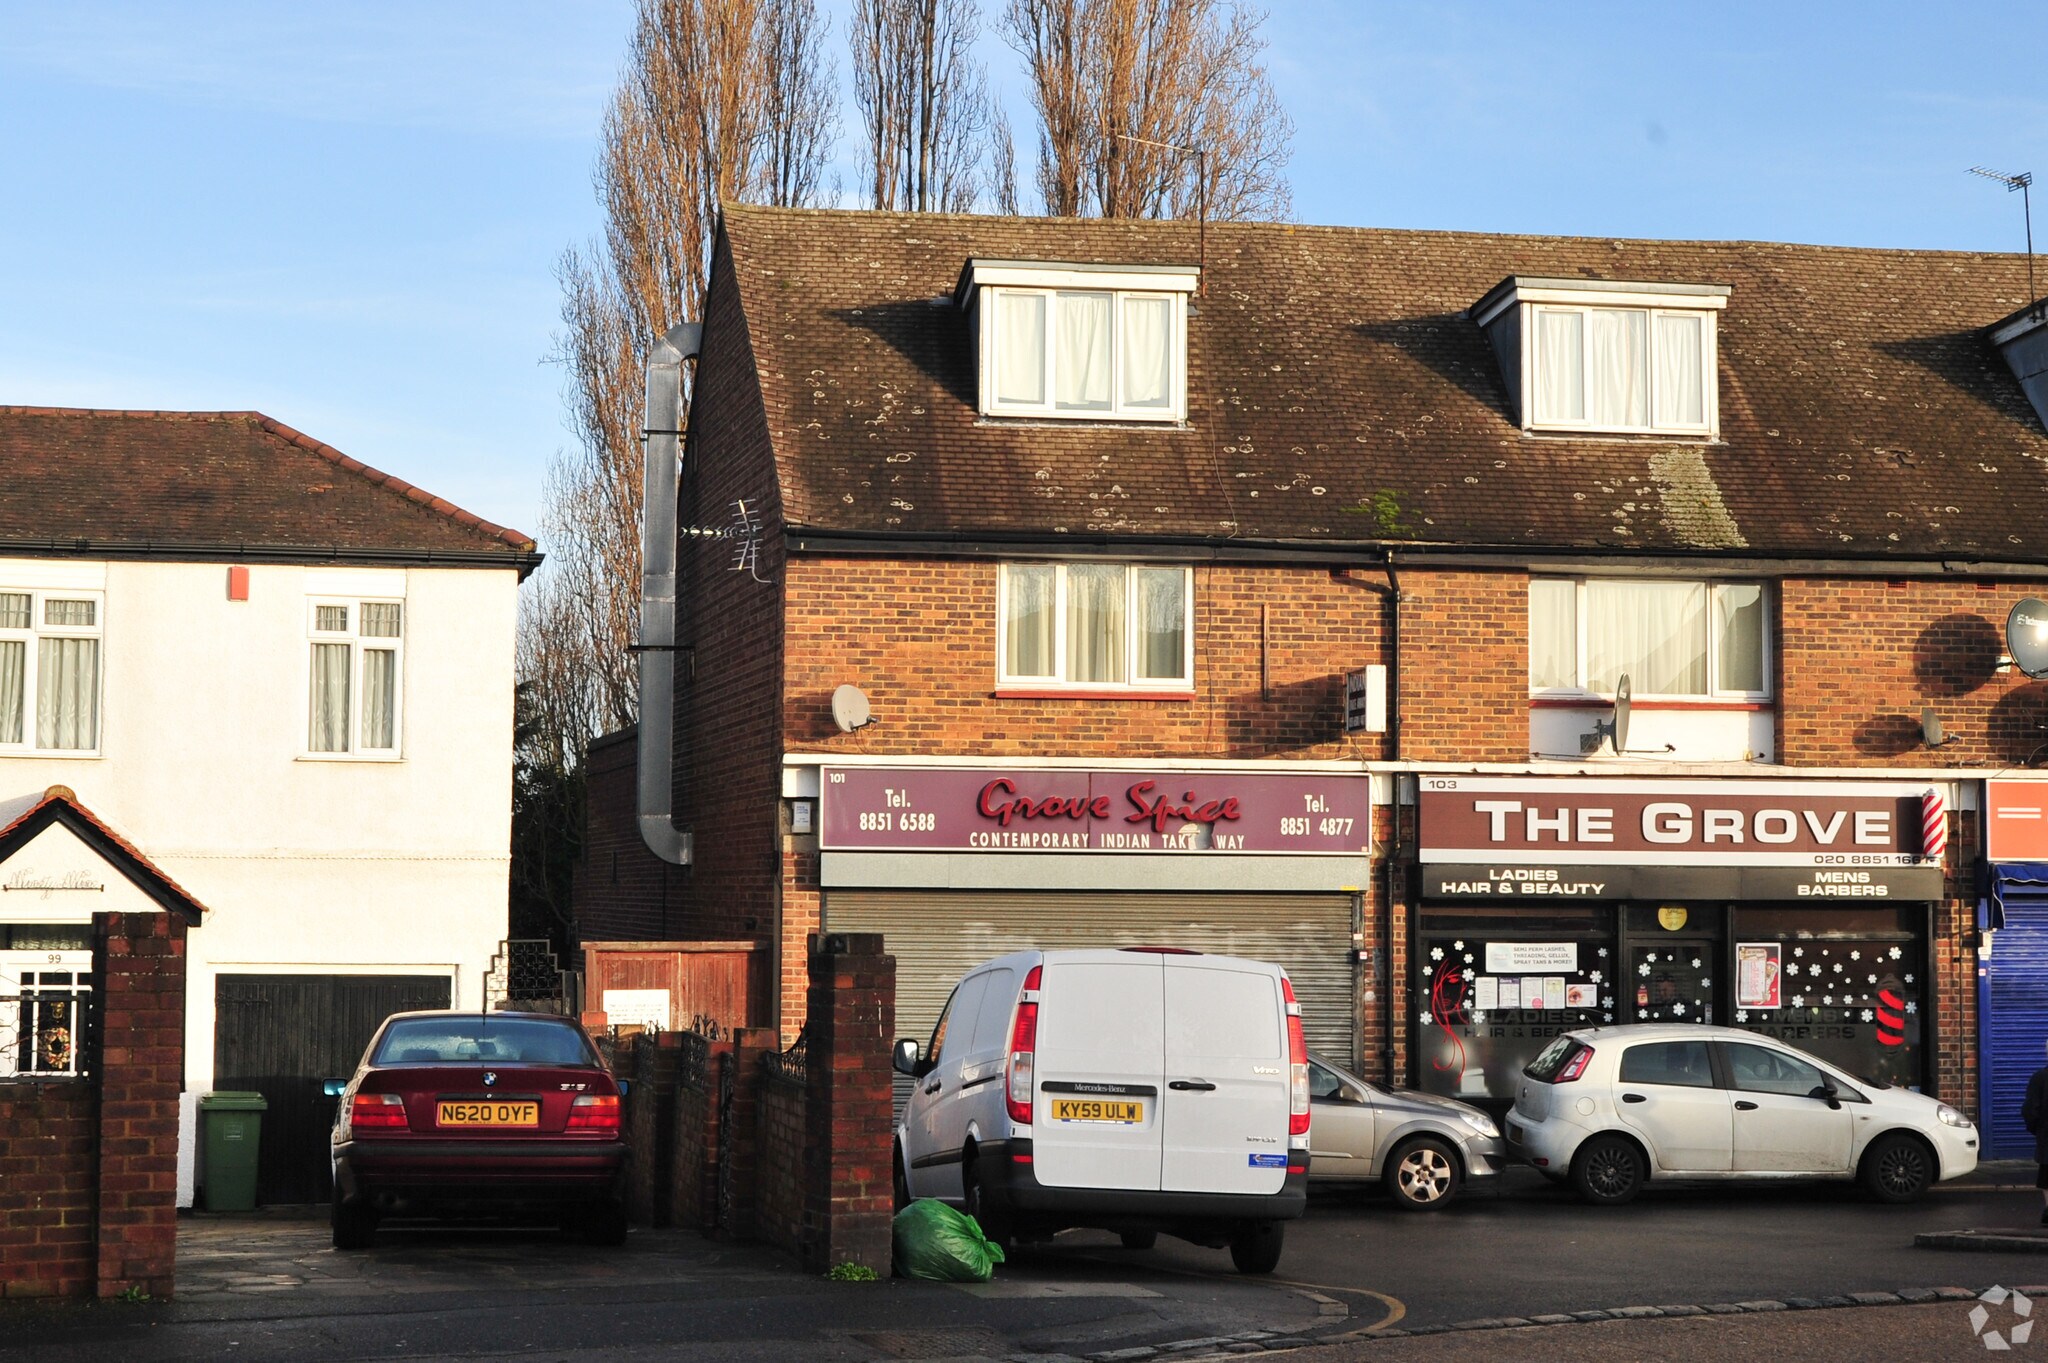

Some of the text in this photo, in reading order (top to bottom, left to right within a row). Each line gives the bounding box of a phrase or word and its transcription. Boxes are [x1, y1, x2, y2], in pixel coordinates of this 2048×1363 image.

[829, 773, 846, 784] 101
[1429, 781, 1458, 790] 103
[885, 788, 911, 808] Tel.
[1304, 794, 1331, 813] Tel.
[979, 777, 1242, 836] Grove Spice
[859, 812, 935, 832] 8851 6588
[1280, 817, 1354, 836] 8851 4877
[1475, 800, 1892, 846] THE GROVE
[969, 832, 1089, 849] CONTEMPORARY
[1101, 833, 1150, 849] INDIAN
[1814, 855, 1845, 864] 020
[1851, 855, 1889, 864] 8851
[1489, 869, 1559, 881] LADIES
[1815, 872, 1870, 883] MENS
[1441, 882, 1605, 895] HAIR & BEAUTY
[1797, 885, 1888, 896] BARBERS
[48, 954, 62, 964] 99
[1490, 1009, 1578, 1023] LADIES
[1074, 1083, 1126, 1093] Mercedes-Benz
[442, 1105, 492, 1121] N620
[1059, 1102, 1136, 1119] KY59 ULW
